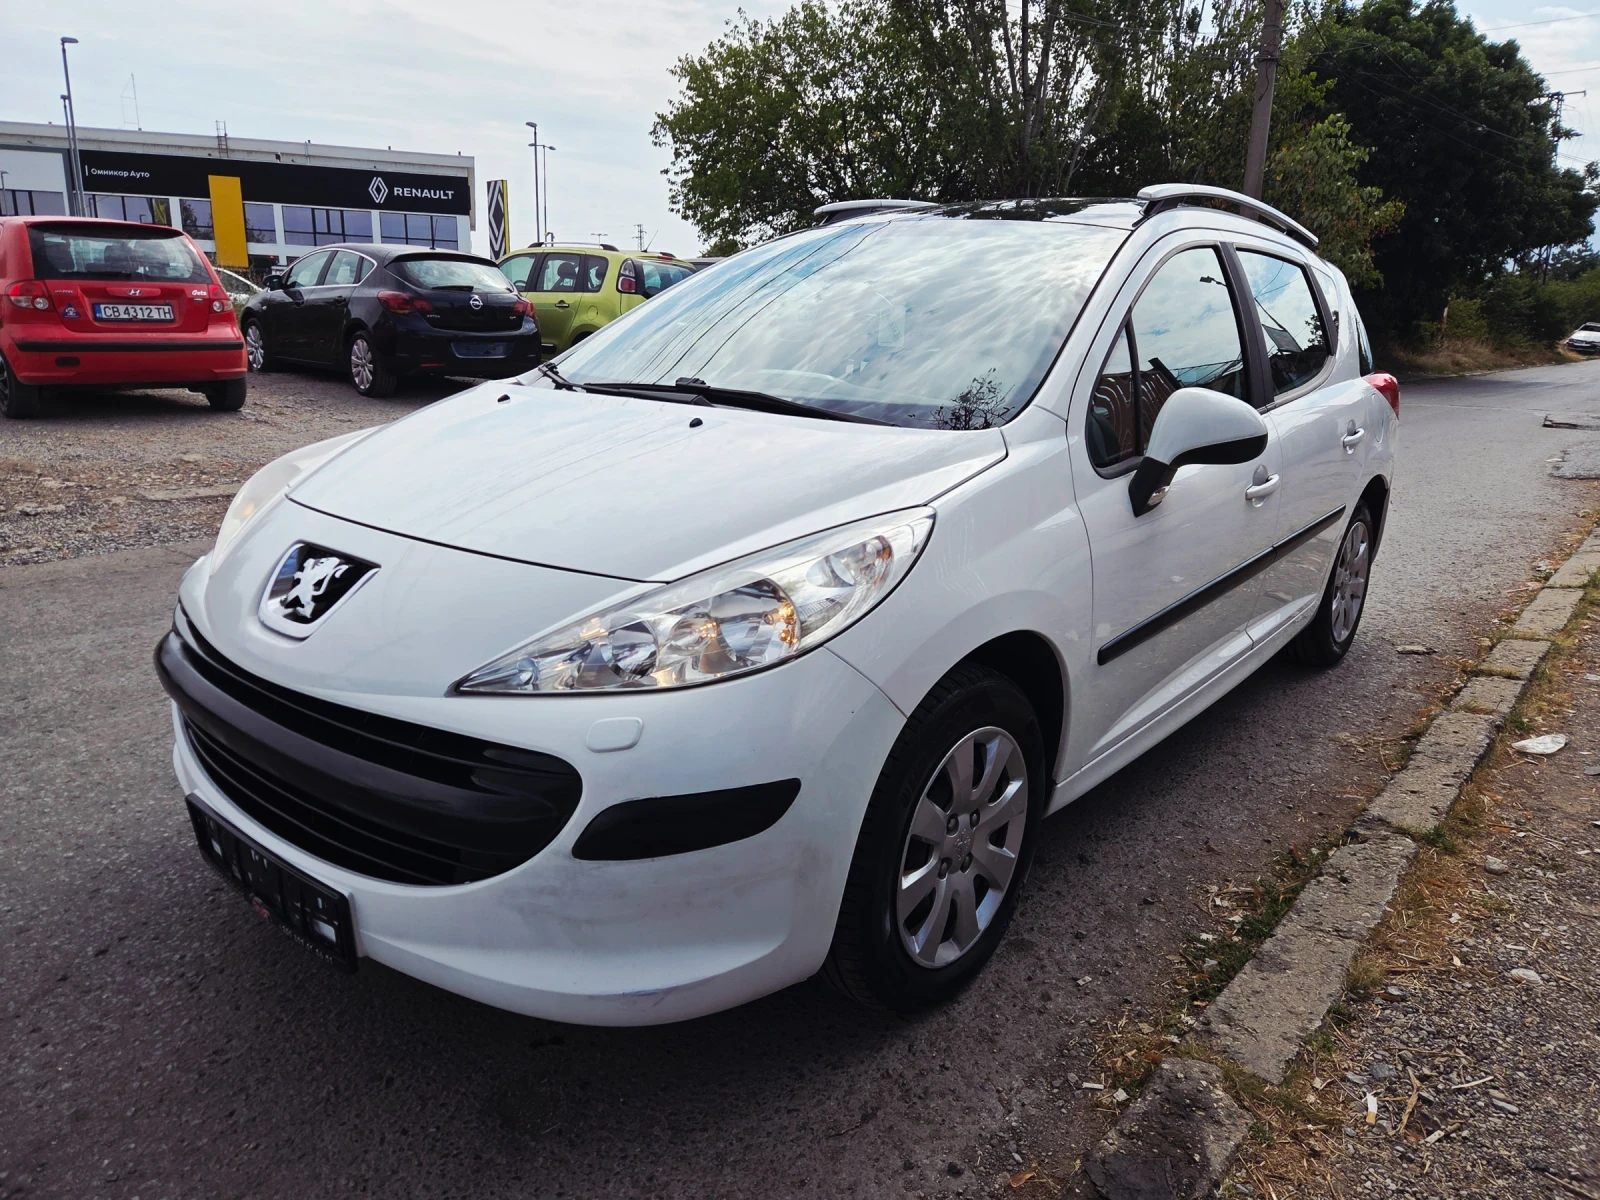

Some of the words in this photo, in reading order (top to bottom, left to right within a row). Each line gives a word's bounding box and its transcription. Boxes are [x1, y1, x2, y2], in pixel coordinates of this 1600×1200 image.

[91, 168, 129, 178] Омникар
[130, 170, 150, 178] Ауто
[393, 187, 455, 200] RENAULT
[103, 305, 121, 318] CB
[123, 306, 154, 319] 4312
[155, 307, 172, 319] TH
